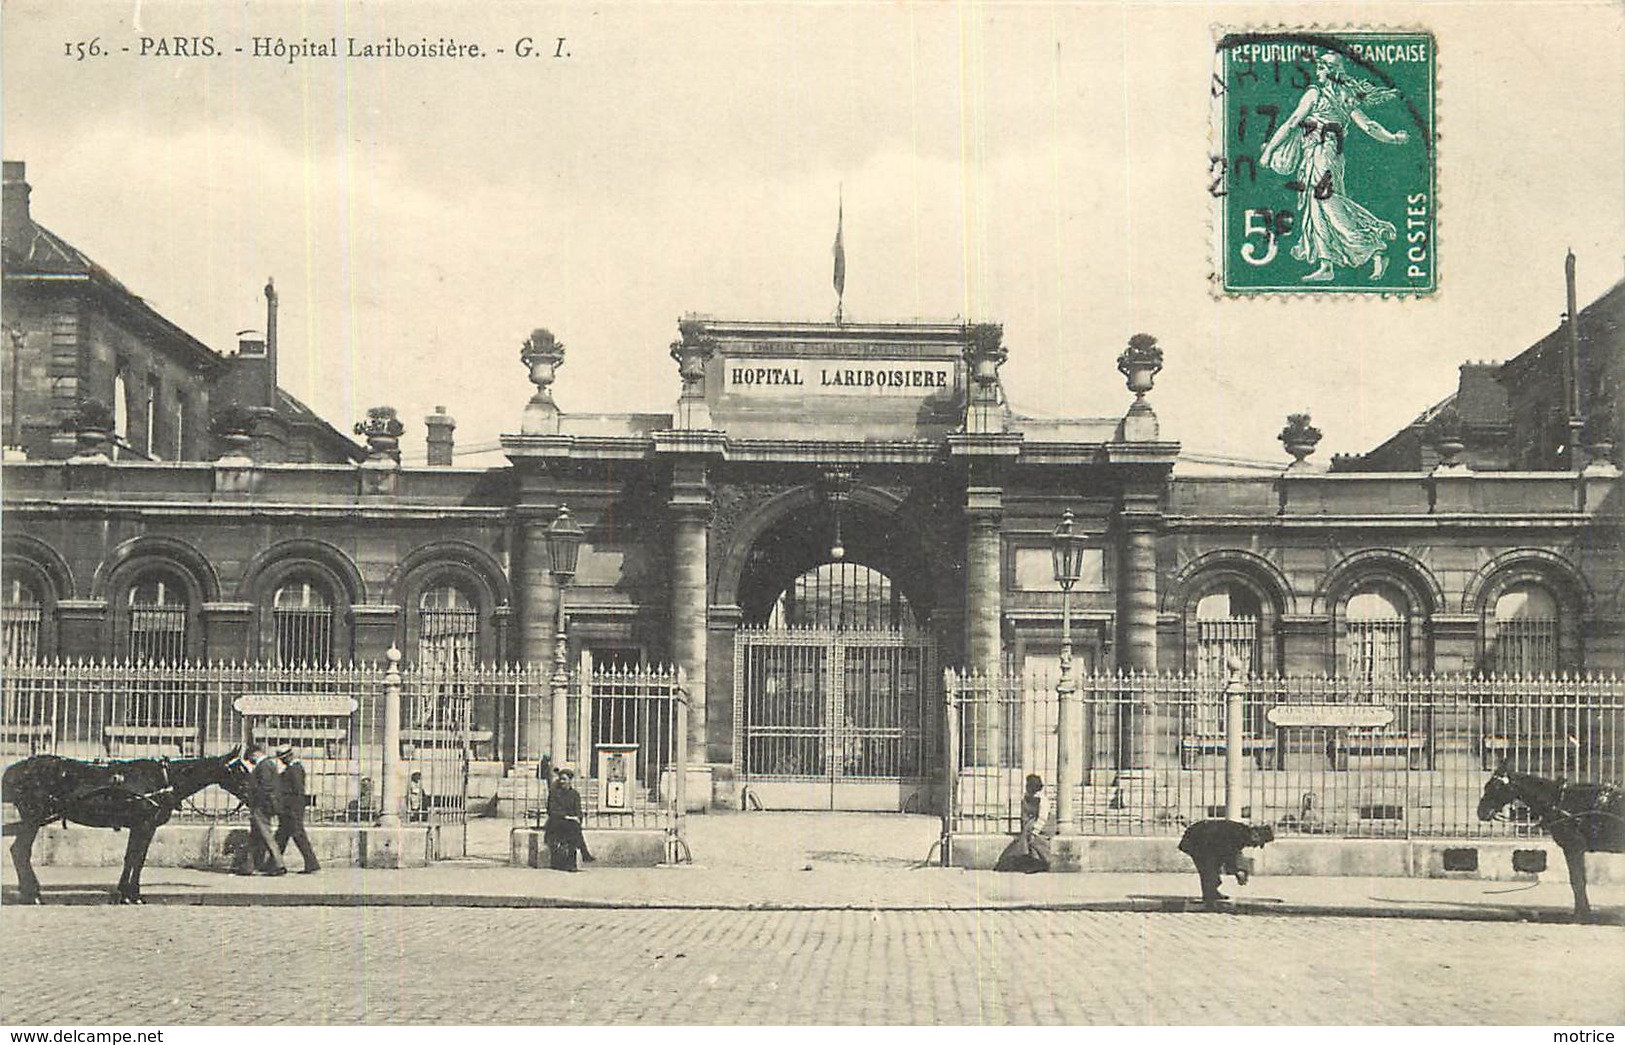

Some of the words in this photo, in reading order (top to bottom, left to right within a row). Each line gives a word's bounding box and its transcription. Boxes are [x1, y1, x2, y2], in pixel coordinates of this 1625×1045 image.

[1407, 193, 1427, 277] POSTES
[732, 368, 804, 385] HOPITAL
[820, 370, 947, 388] LARIBOISIERE
